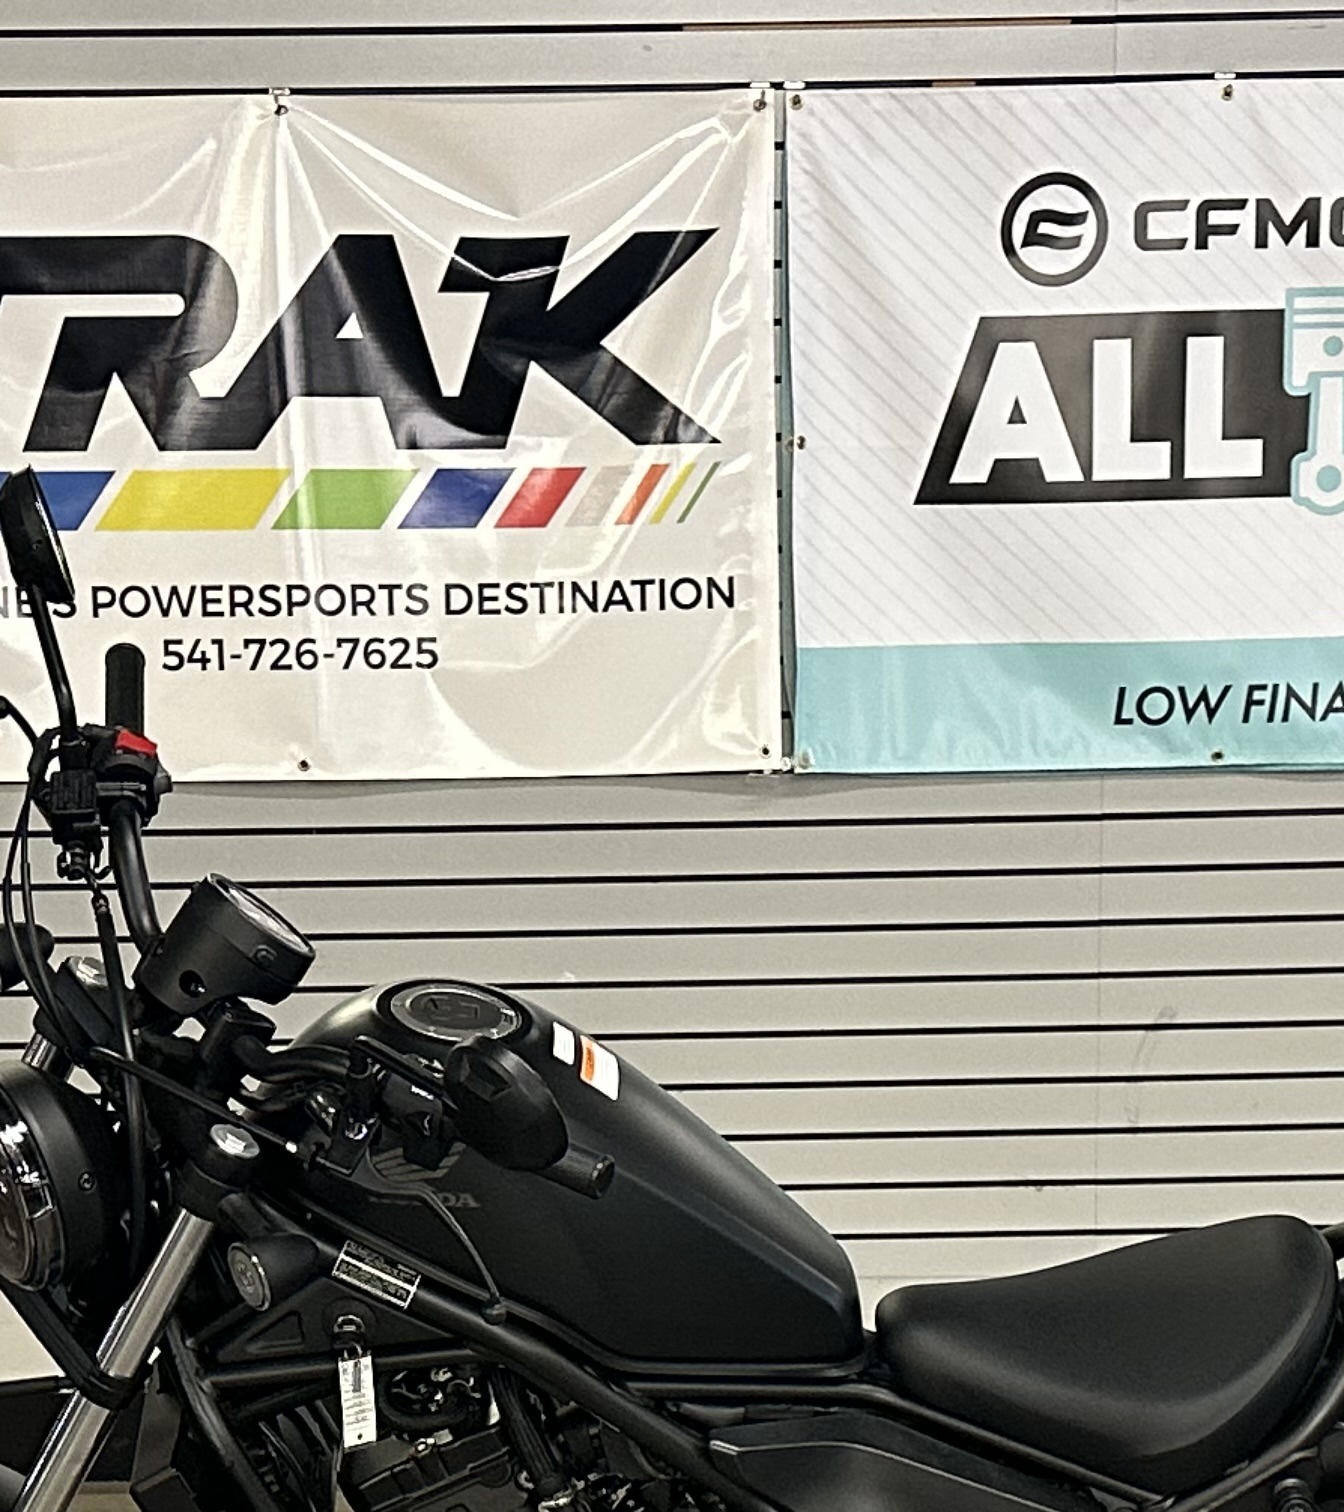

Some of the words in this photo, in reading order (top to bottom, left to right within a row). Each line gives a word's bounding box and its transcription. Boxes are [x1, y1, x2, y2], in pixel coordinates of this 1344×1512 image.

[949, 334, 1264, 484] ALL
[91, 583, 430, 618] POWERSPORTS
[443, 576, 737, 616] DESTINATION
[161, 636, 439, 672] 541-726-7625
[1113, 684, 1233, 726] LOW
